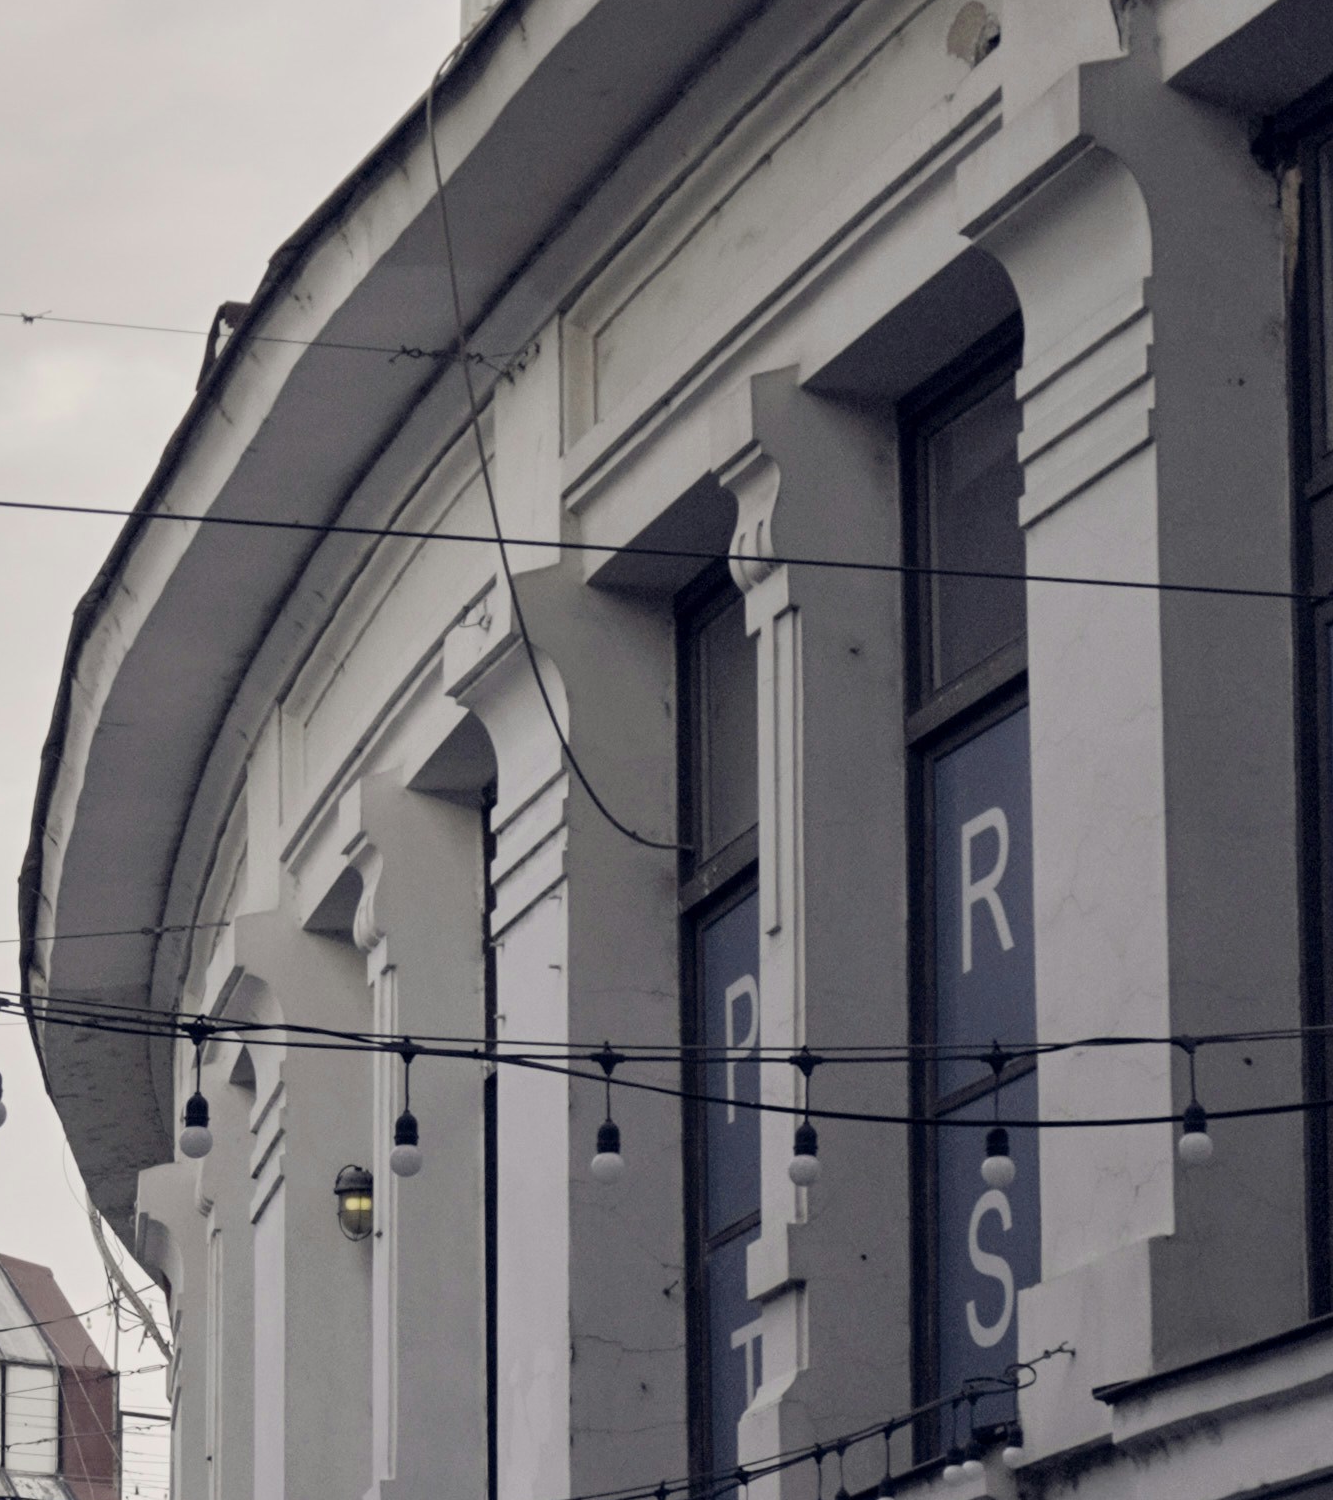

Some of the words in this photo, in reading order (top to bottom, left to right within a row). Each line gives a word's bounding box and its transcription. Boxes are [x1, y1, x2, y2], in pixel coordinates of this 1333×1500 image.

[725, 973, 759, 1124] P
[958, 805, 1016, 976] R
[965, 1189, 1015, 1348] S
